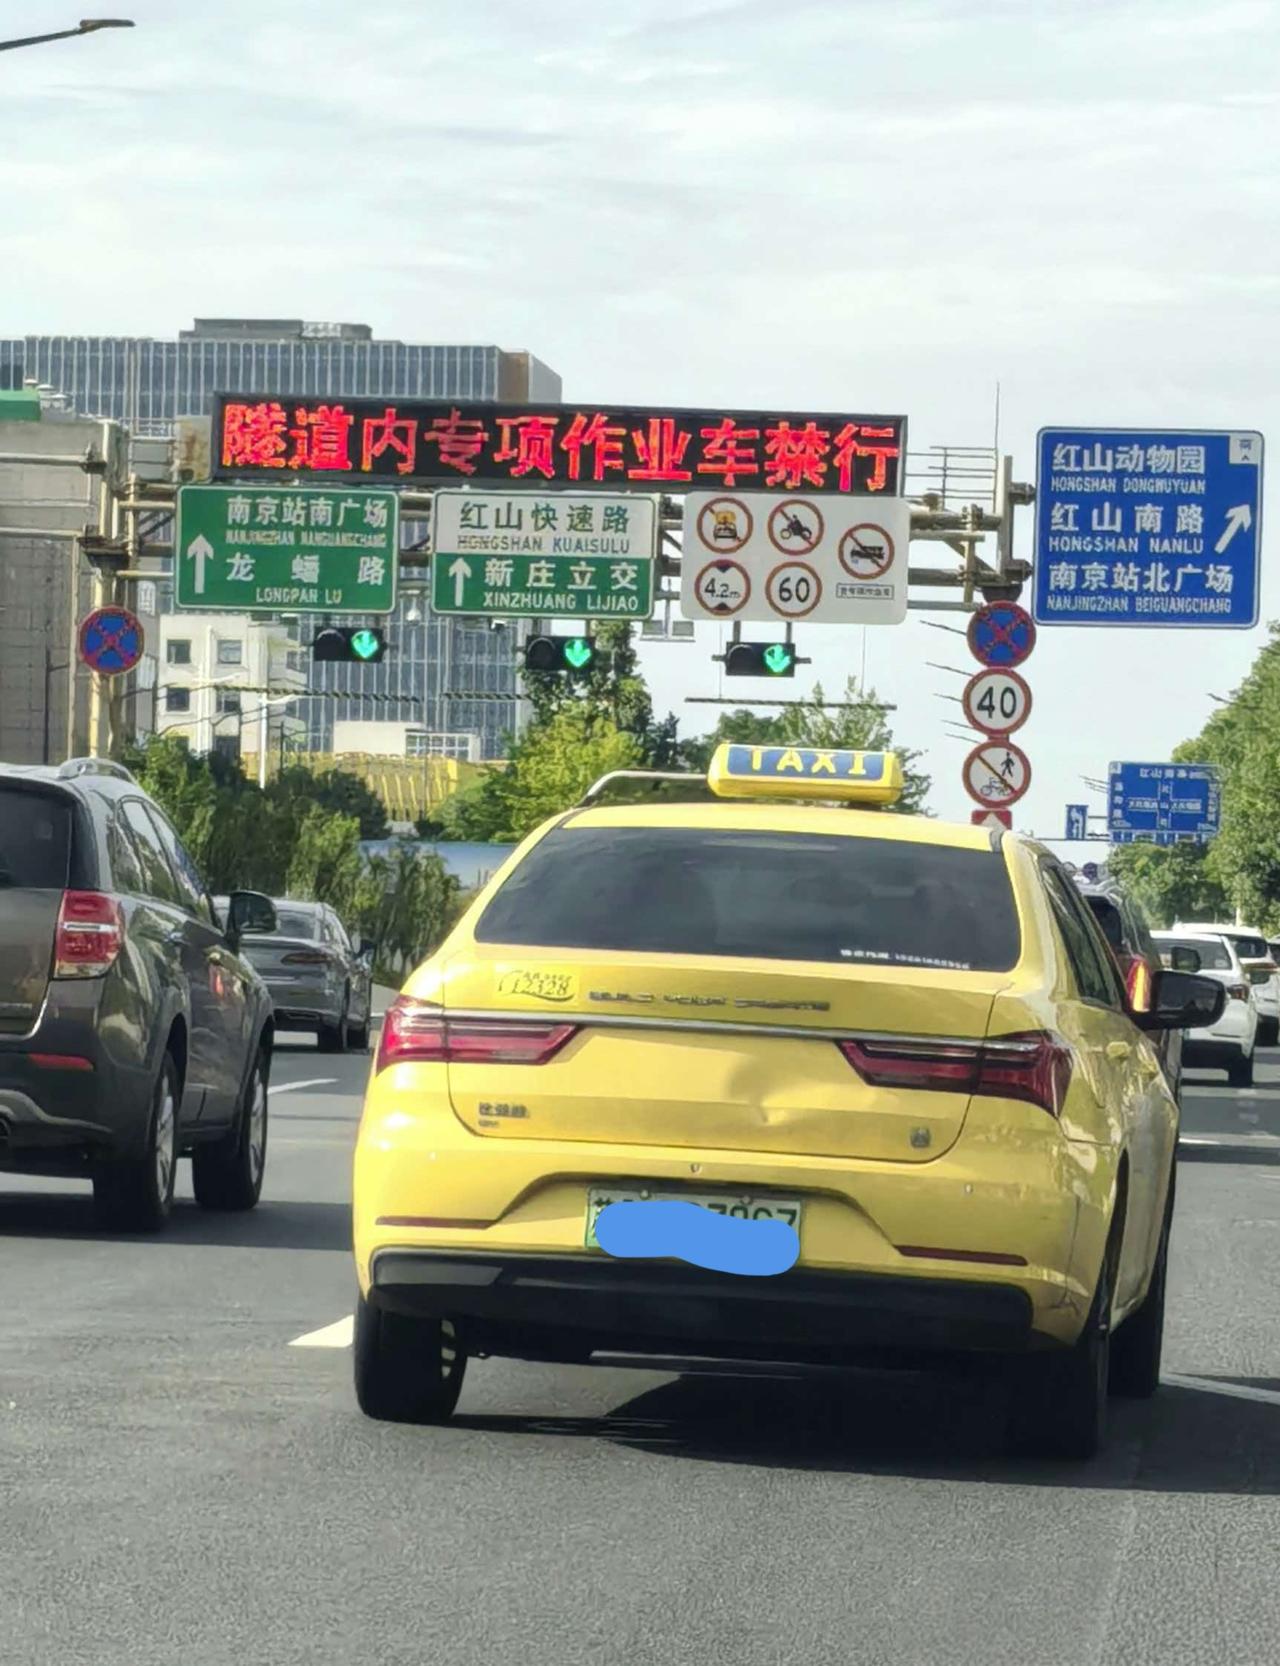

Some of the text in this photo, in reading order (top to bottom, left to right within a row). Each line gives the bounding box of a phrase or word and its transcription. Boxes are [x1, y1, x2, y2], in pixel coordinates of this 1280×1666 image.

[222, 402, 899, 491] 隧道内专项作业车禁行
[1052, 443, 1206, 474] 红山动物园
[1051, 476, 1206, 495] HONGSHAN DONGWUYUAN
[226, 494, 388, 528] 南京站南广场
[459, 501, 630, 534] 红山快速路
[1050, 501, 1204, 534] 红山南路
[457, 534, 630, 554] HONGSHAN KUAISULU
[1049, 536, 1204, 554] HONGSHAN NANLU
[226, 552, 386, 586] 龙蟠路
[484, 558, 638, 591] 新庄立交
[1049, 562, 1234, 593] 南京站北广场
[256, 587, 343, 604] LONGPAN LU
[482, 592, 639, 611] XINZHUANG LIJIAO
[704, 577, 742, 599] 4.2m
[778, 577, 811, 603] 60
[1047, 595, 1232, 614] NANJINGZHAN BEIGUANGCHANG
[976, 686, 1018, 719] 40
[748, 748, 867, 775] TAXI
